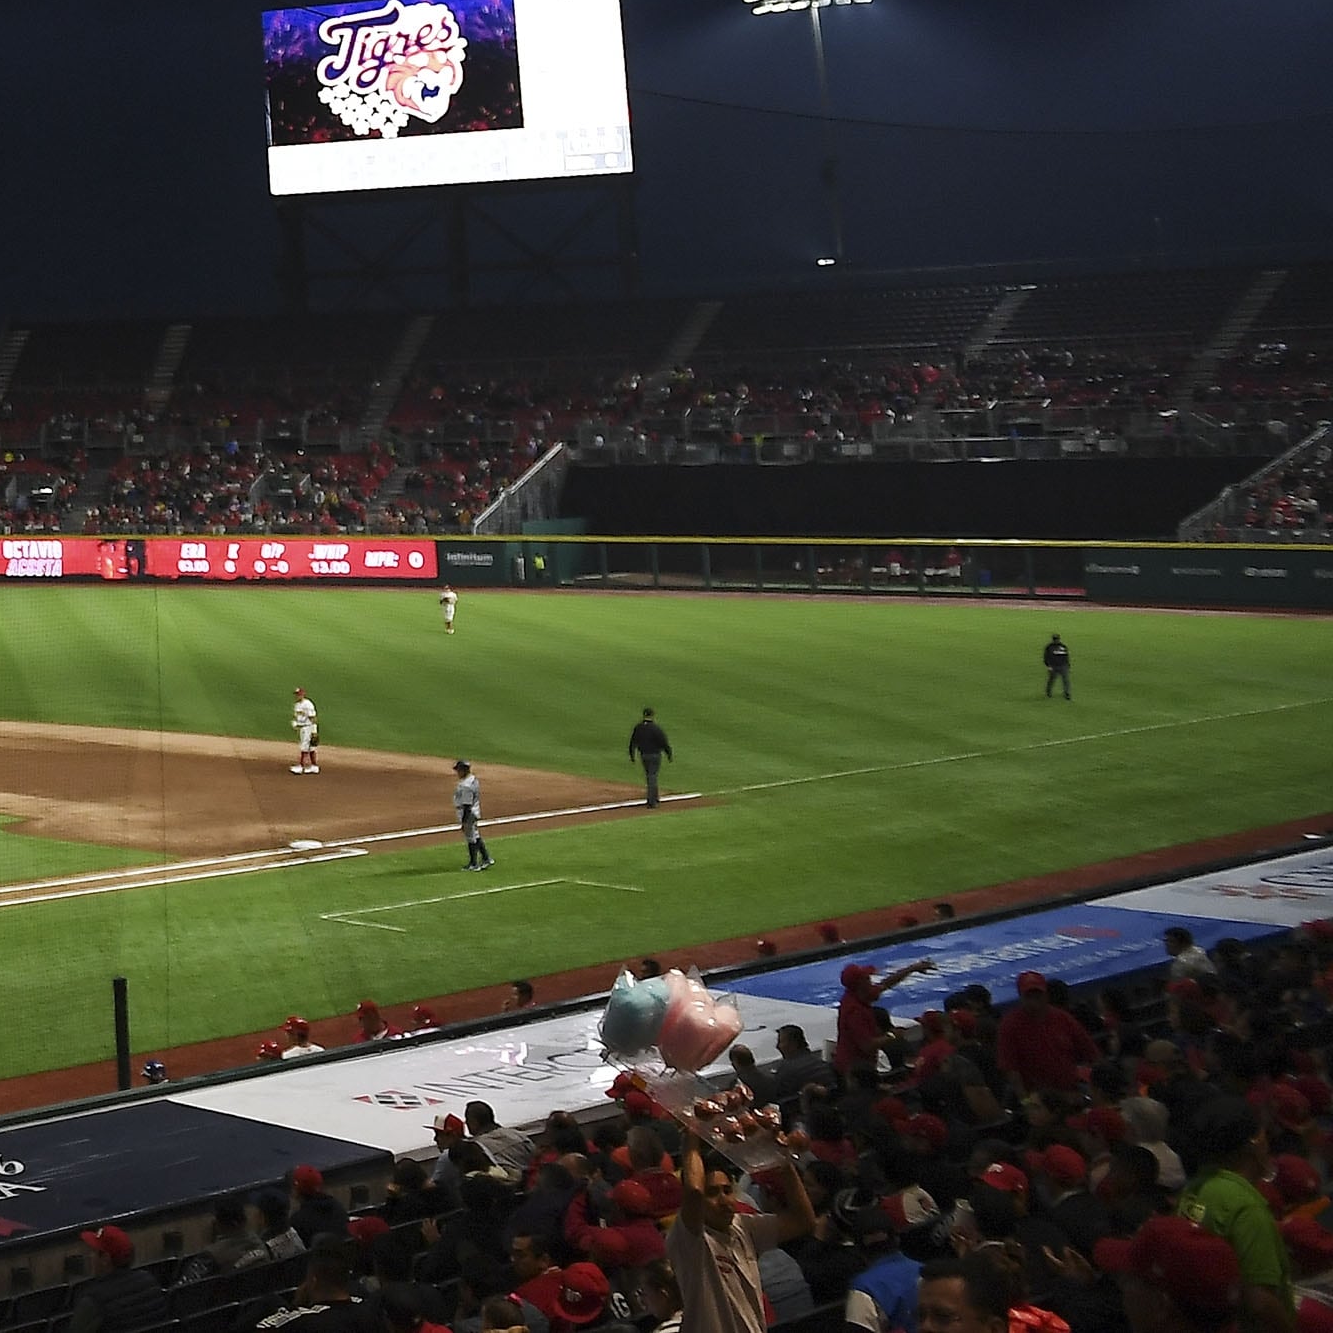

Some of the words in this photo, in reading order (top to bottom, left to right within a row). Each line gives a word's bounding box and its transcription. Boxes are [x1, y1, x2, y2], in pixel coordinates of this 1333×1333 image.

[321, 3, 454, 90] Tigres
[3, 541, 62, 558] OCTAVIO
[6, 559, 62, 576] ACOSTA
[409, 552, 423, 568] 0
